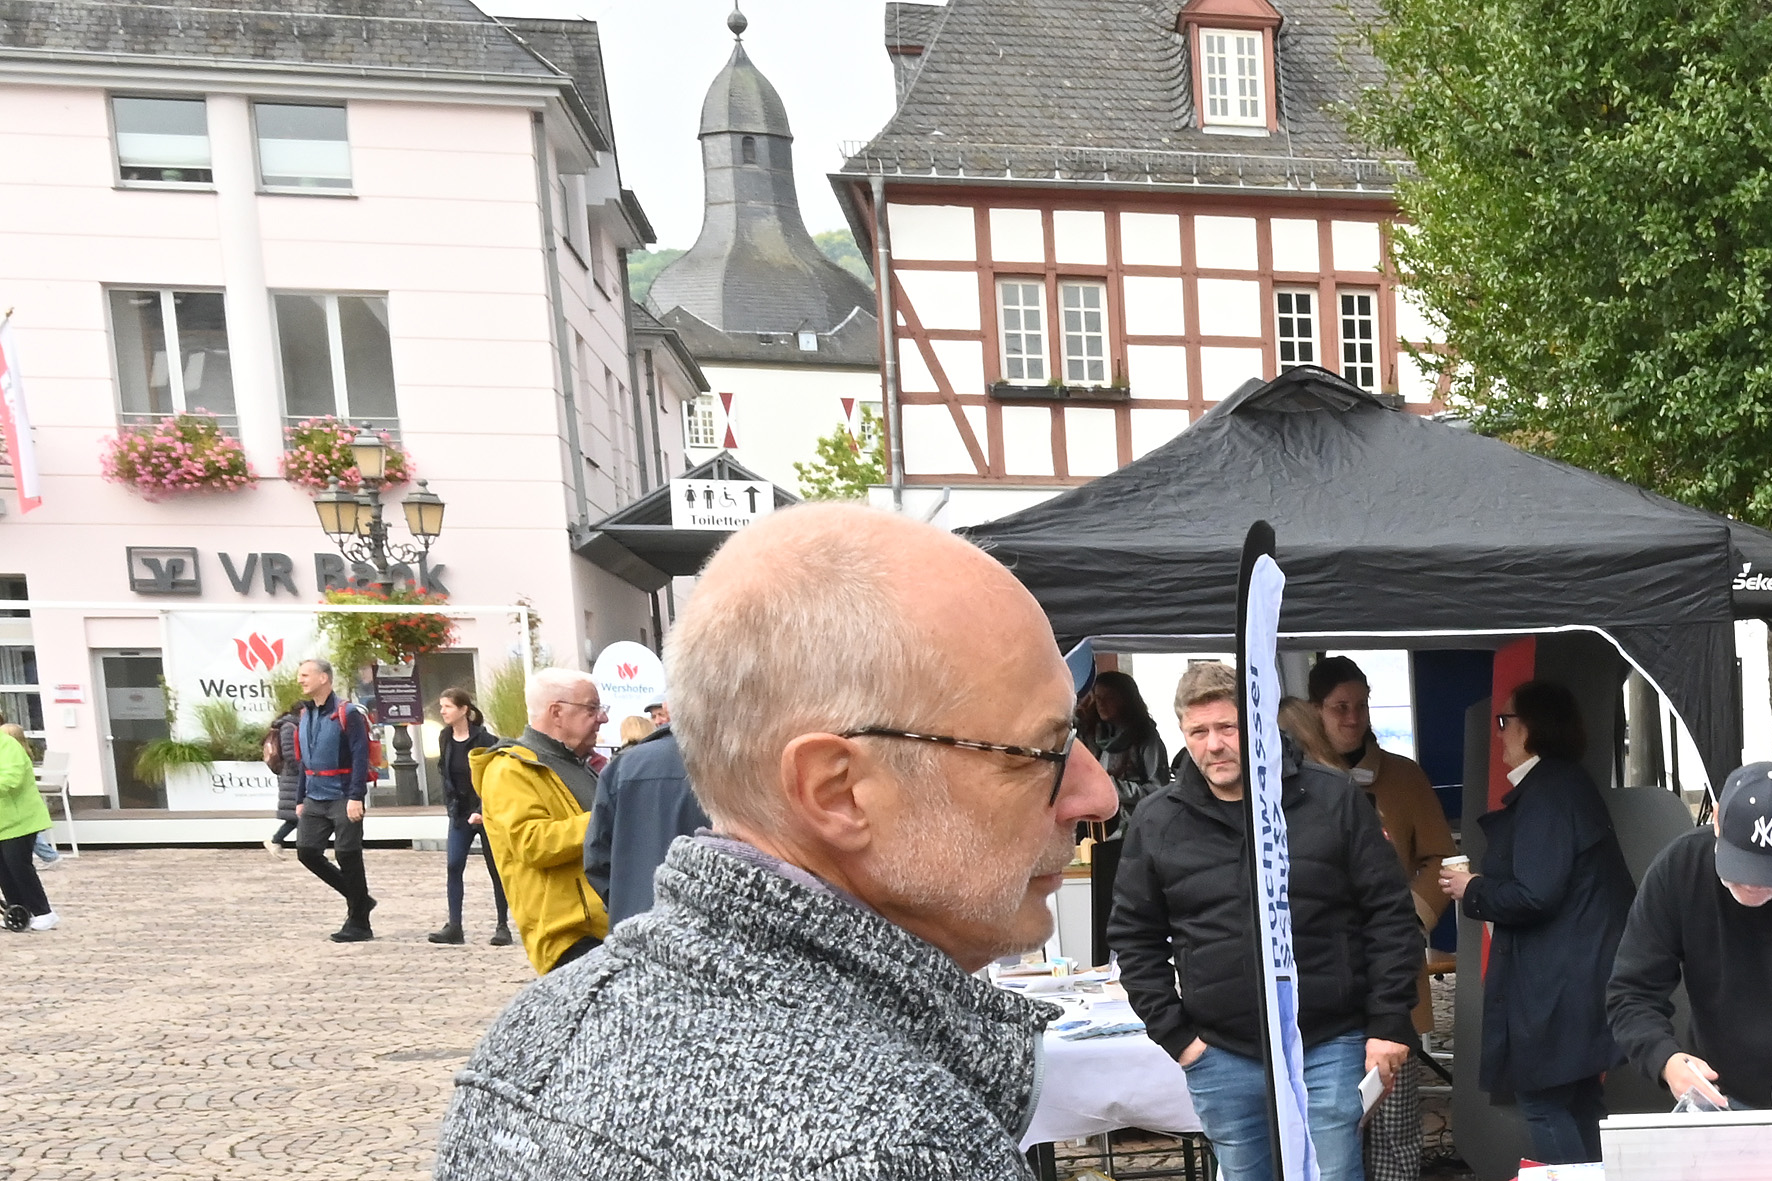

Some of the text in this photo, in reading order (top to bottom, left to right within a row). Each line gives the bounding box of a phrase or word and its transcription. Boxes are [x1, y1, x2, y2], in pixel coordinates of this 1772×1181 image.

[690, 515, 750, 526] Toiletten
[217, 550, 450, 596] VR Bank
[601, 682, 654, 693] Wershofen
